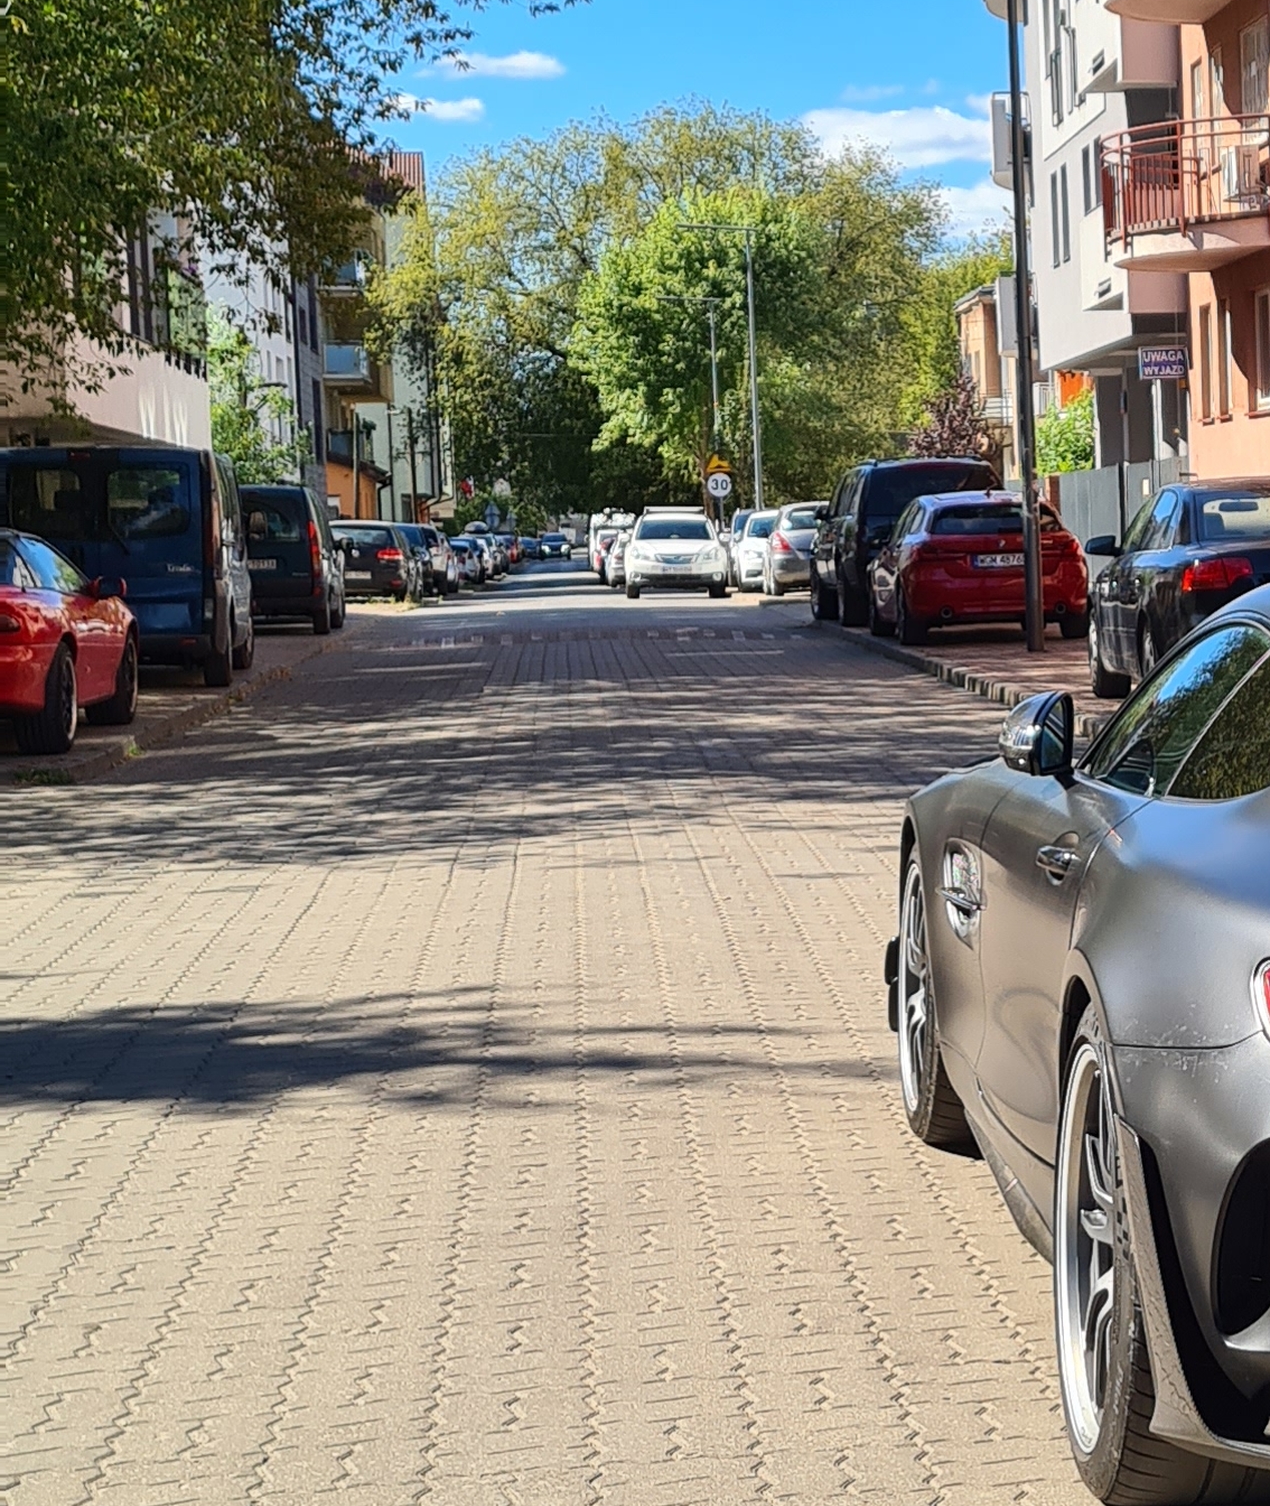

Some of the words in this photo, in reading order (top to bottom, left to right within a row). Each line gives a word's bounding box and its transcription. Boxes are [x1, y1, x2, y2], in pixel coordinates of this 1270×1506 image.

[1142, 350, 1184, 363] UWAGA
[1143, 365, 1185, 376] WYJAZD
[711, 478, 728, 491] 30
